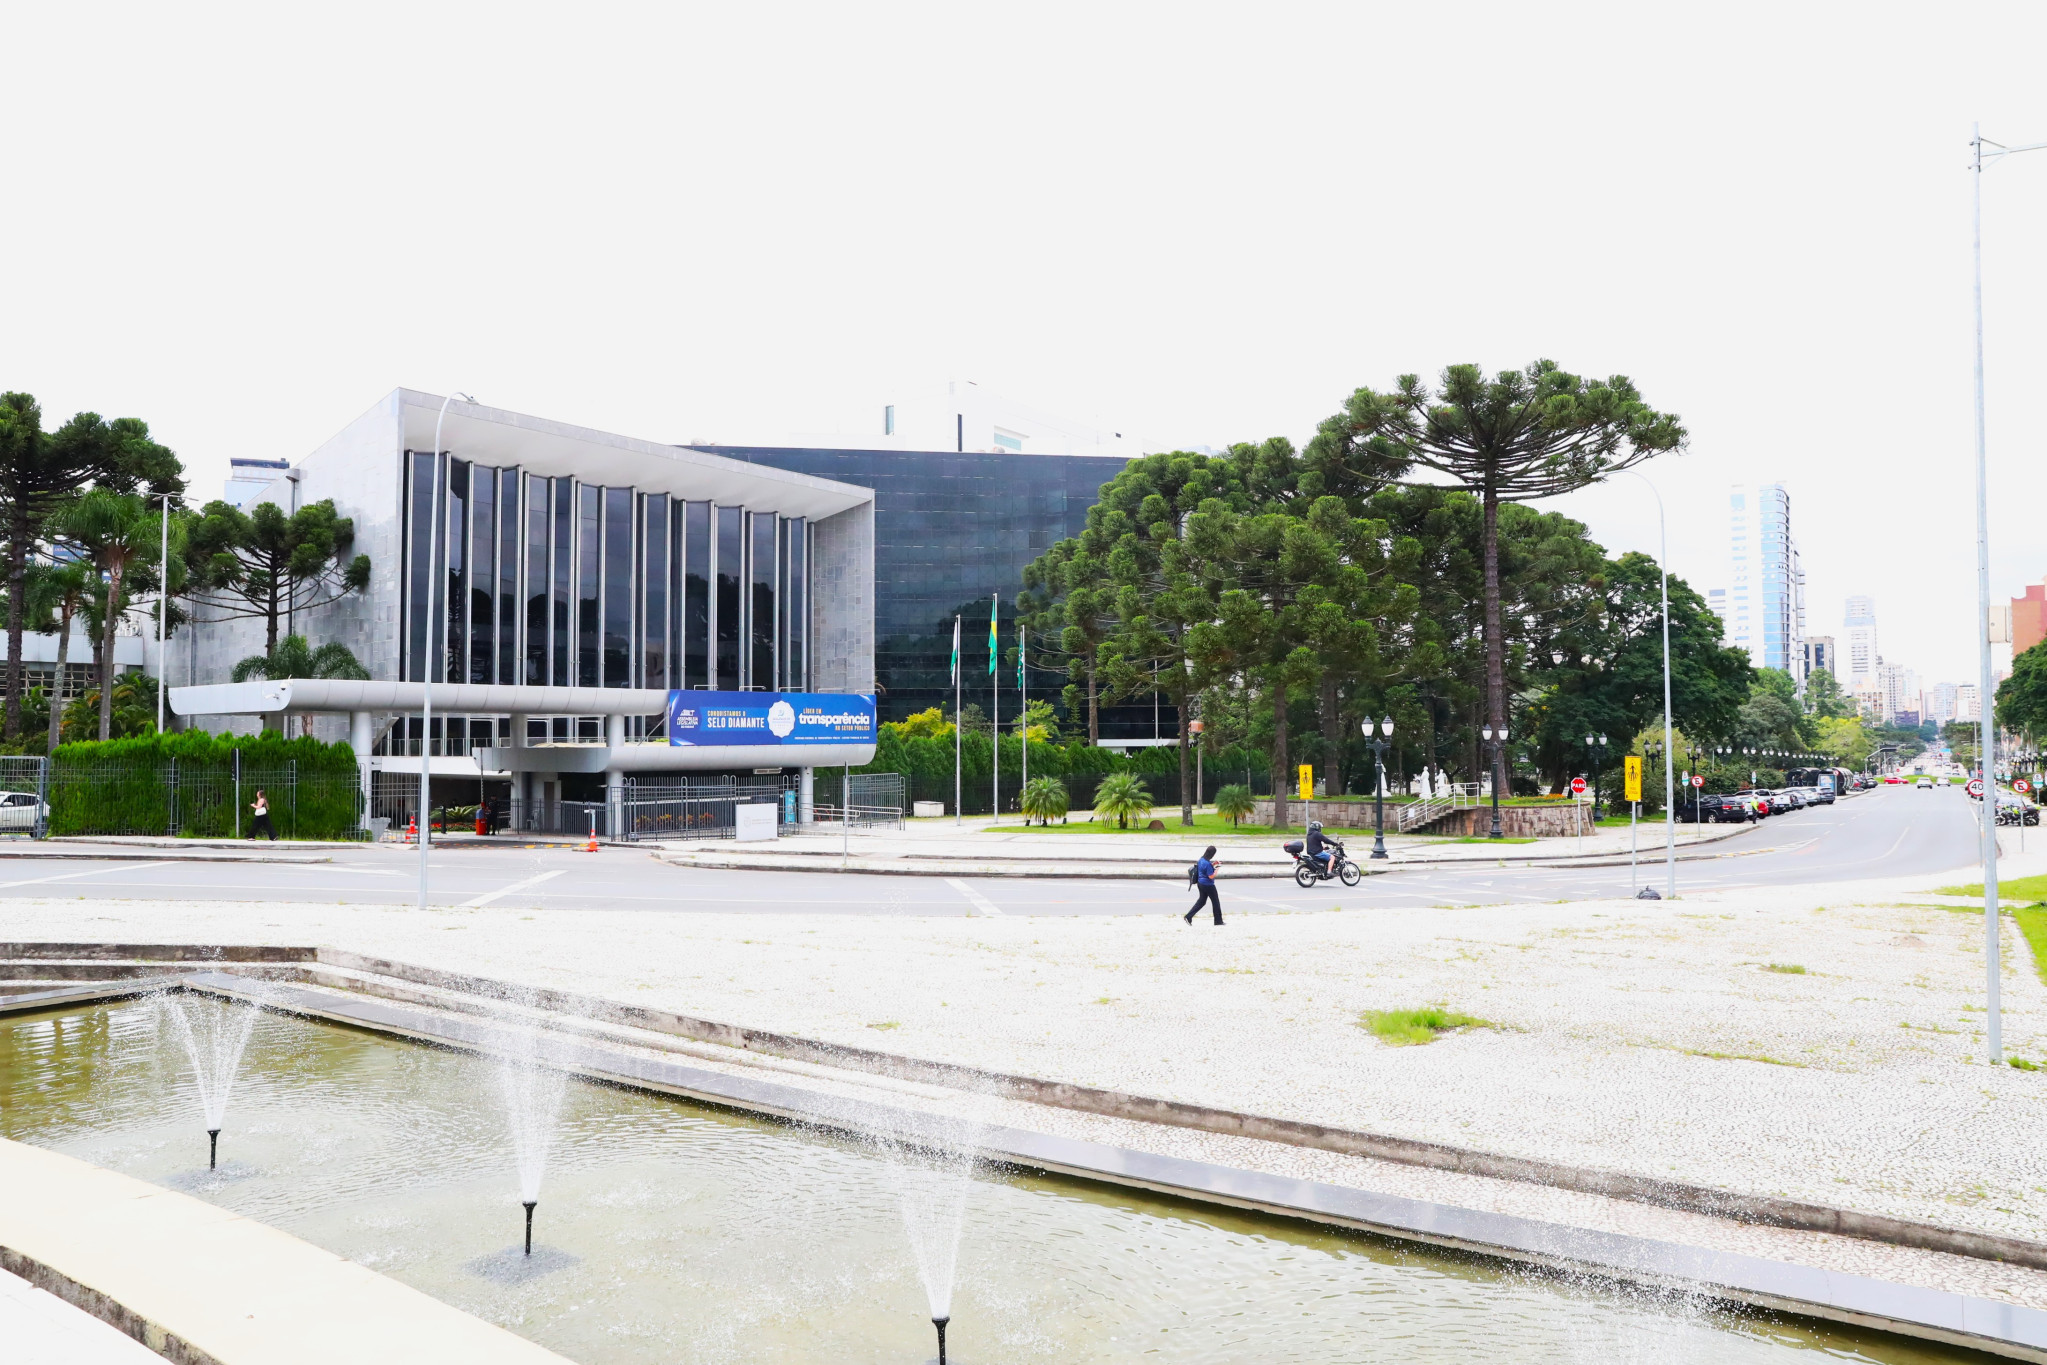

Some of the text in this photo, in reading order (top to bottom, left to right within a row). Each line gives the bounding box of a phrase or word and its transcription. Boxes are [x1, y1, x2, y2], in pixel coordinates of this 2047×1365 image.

[707, 717, 726, 728] SELO
[728, 717, 765, 728] DIAMANTE
[798, 711, 870, 728] transparência
[1971, 783, 1984, 791] 40
